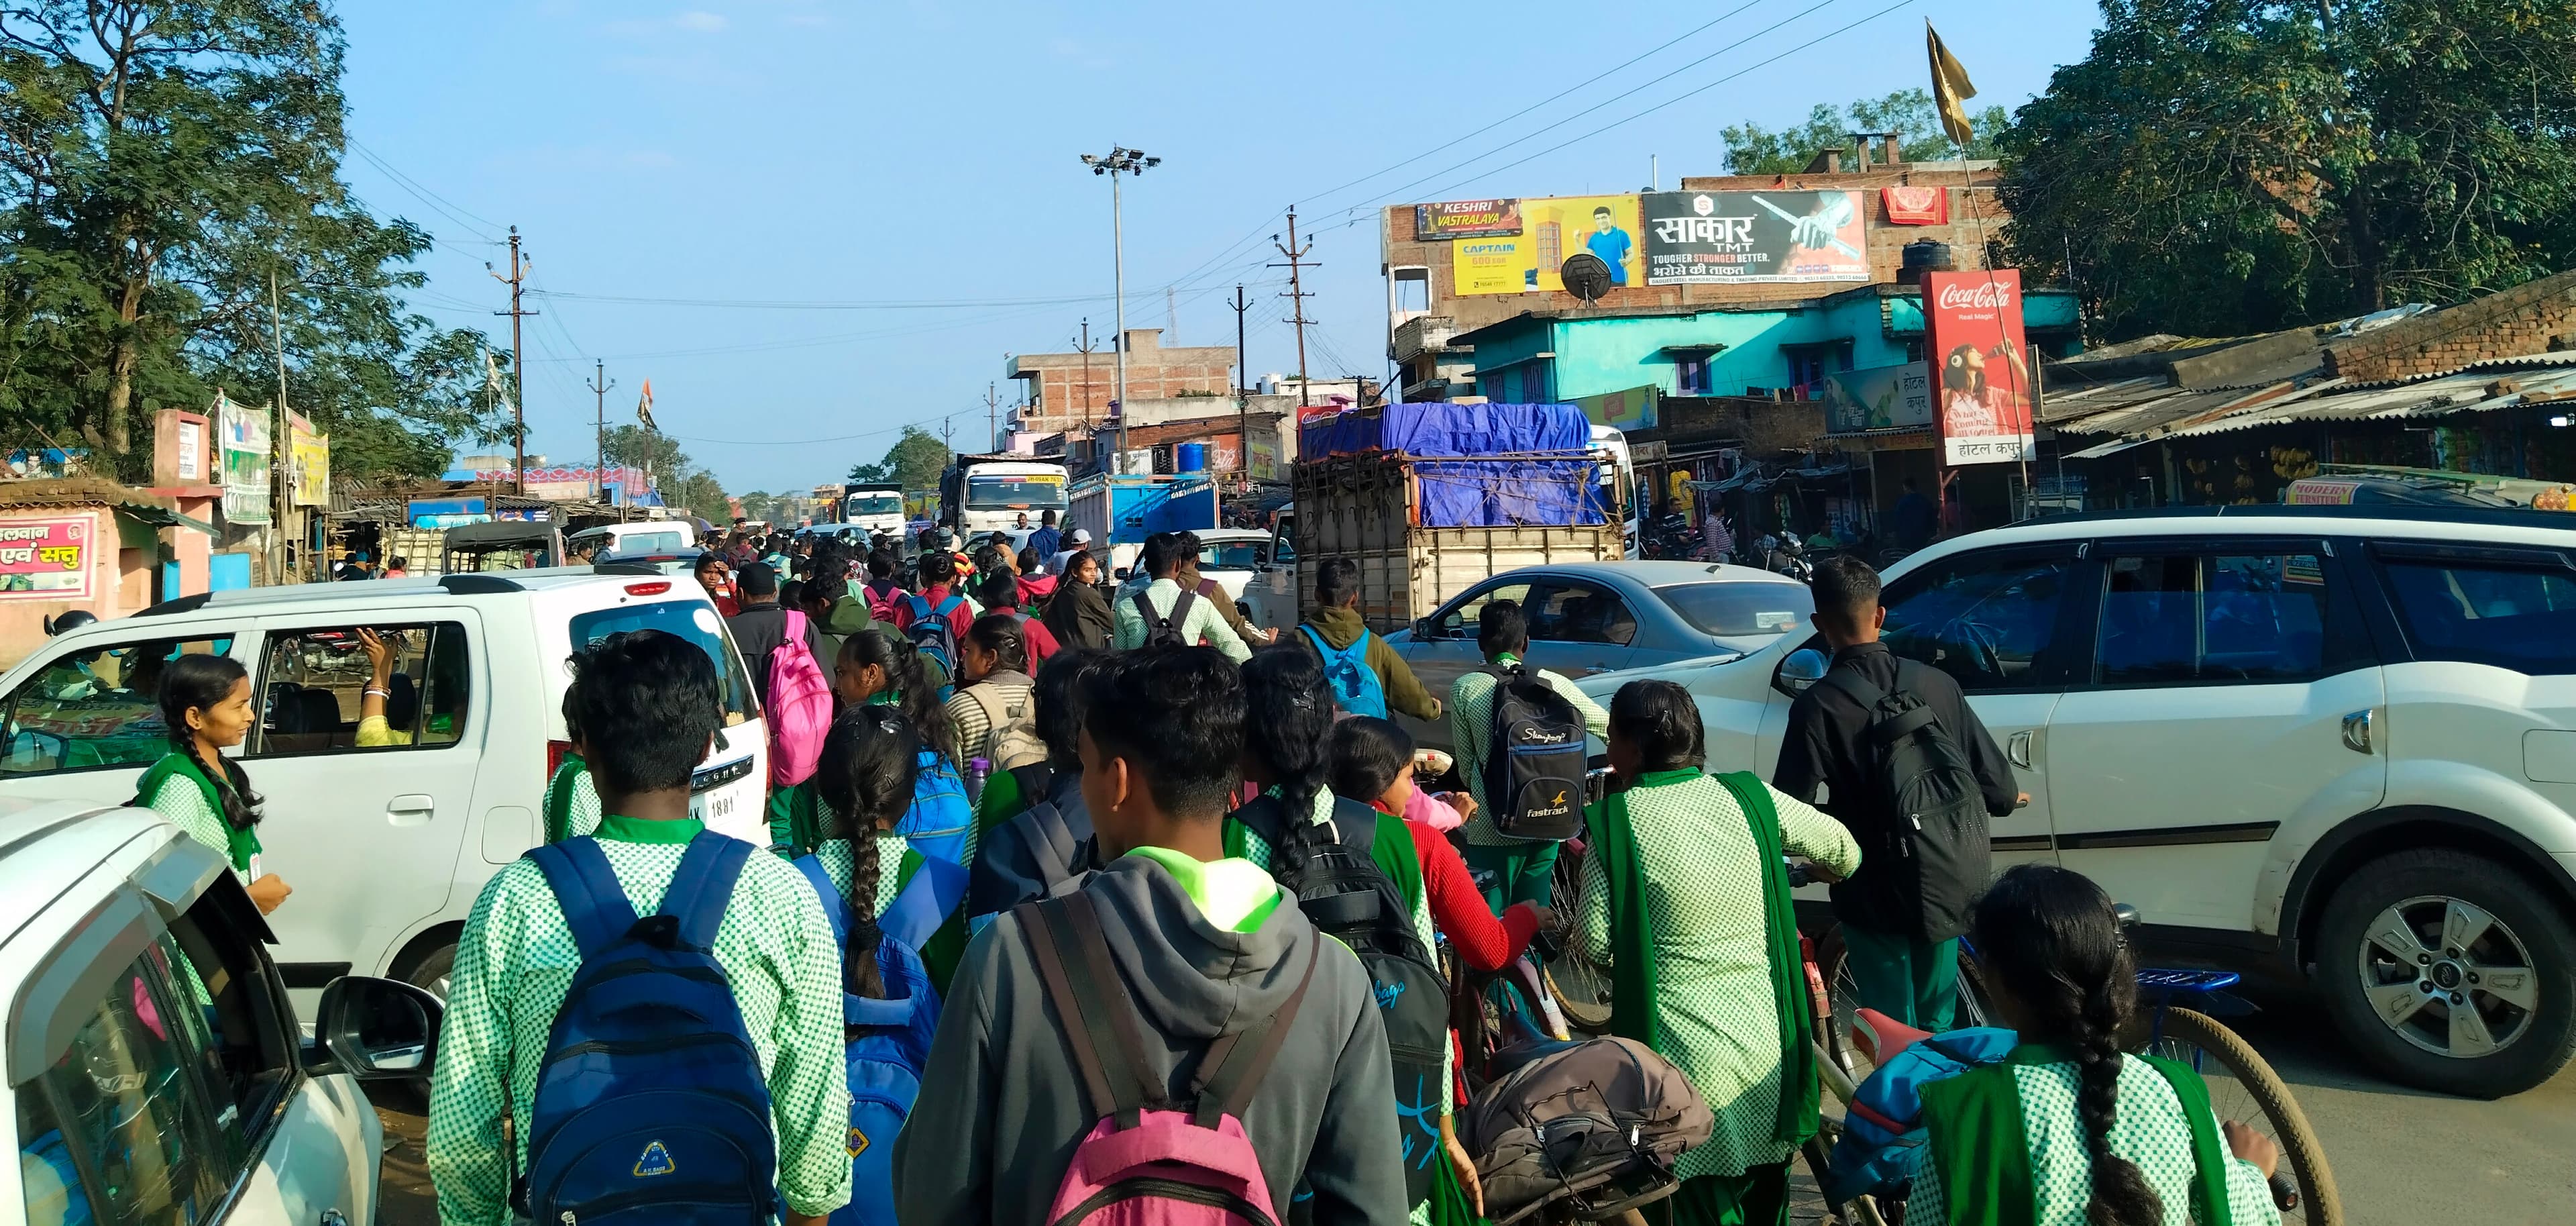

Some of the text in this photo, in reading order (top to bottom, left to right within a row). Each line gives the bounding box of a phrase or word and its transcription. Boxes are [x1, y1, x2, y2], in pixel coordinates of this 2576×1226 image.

[1444, 202, 1493, 213] KESHRI
[1438, 213, 1499, 227] VASTRALAYA
[1652, 217, 1756, 244] साकार
[1463, 244, 1515, 254] CAPTAIN
[1713, 243, 1754, 253] TMT
[1652, 253, 1770, 264] TOUGHER STRONGER BETTER.
[1653, 262, 1745, 276] भरोसे की ताकत
[1974, 313, 1994, 321] Magic
[1902, 372, 1926, 393] होटल
[1957, 440, 1991, 457] होटल
[2296, 484, 2349, 495] MODERN
[2296, 494, 2341, 503] FURNITURE
[0, 542, 38, 566] एवं
[711, 796, 734, 819] 1881
[1527, 805, 1568, 817] fastrack
